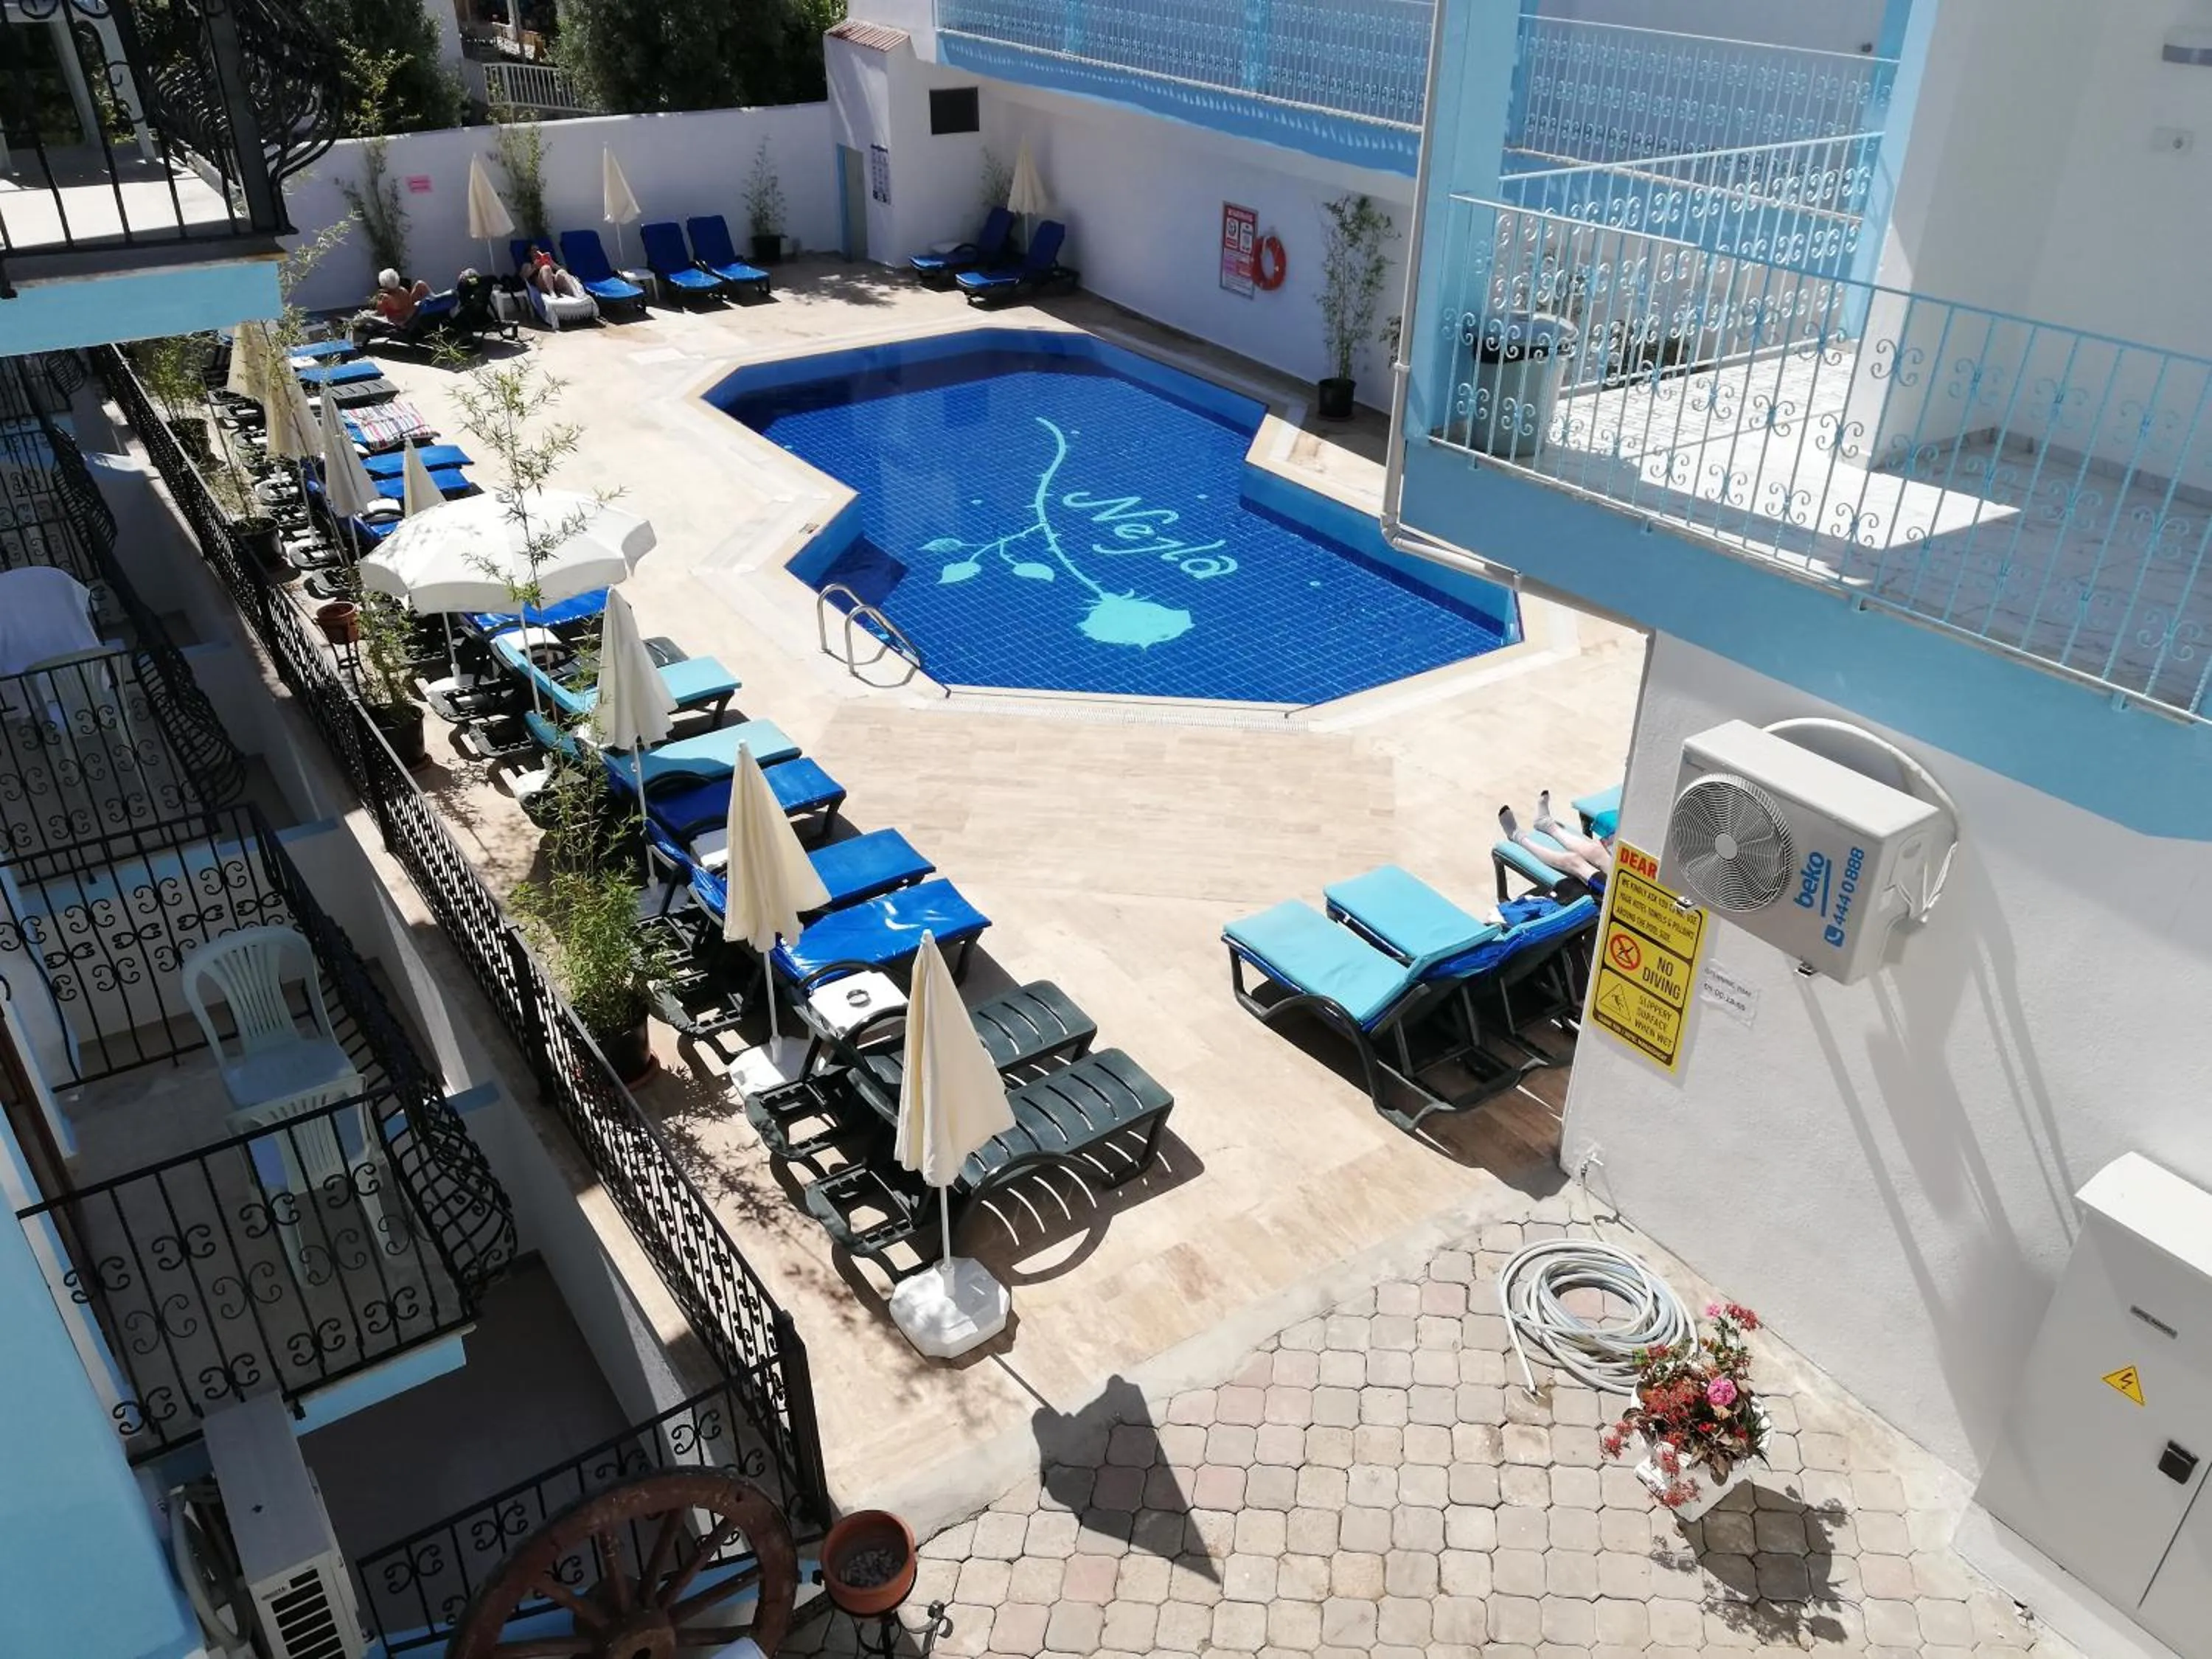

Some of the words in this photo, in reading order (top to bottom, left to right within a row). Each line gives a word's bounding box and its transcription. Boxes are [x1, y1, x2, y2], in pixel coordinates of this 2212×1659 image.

[1620, 846, 1658, 880] DEAR
[1793, 852, 1825, 908] beko
[1657, 957, 1674, 977] NO
[1642, 967, 1681, 1000] DIVING
[1637, 1006, 1669, 1032] SURFACE
[1639, 995, 1673, 1020] SLIPPERY
[1635, 1018, 1655, 1037] WHEN
[1657, 1034, 1672, 1048] WET
